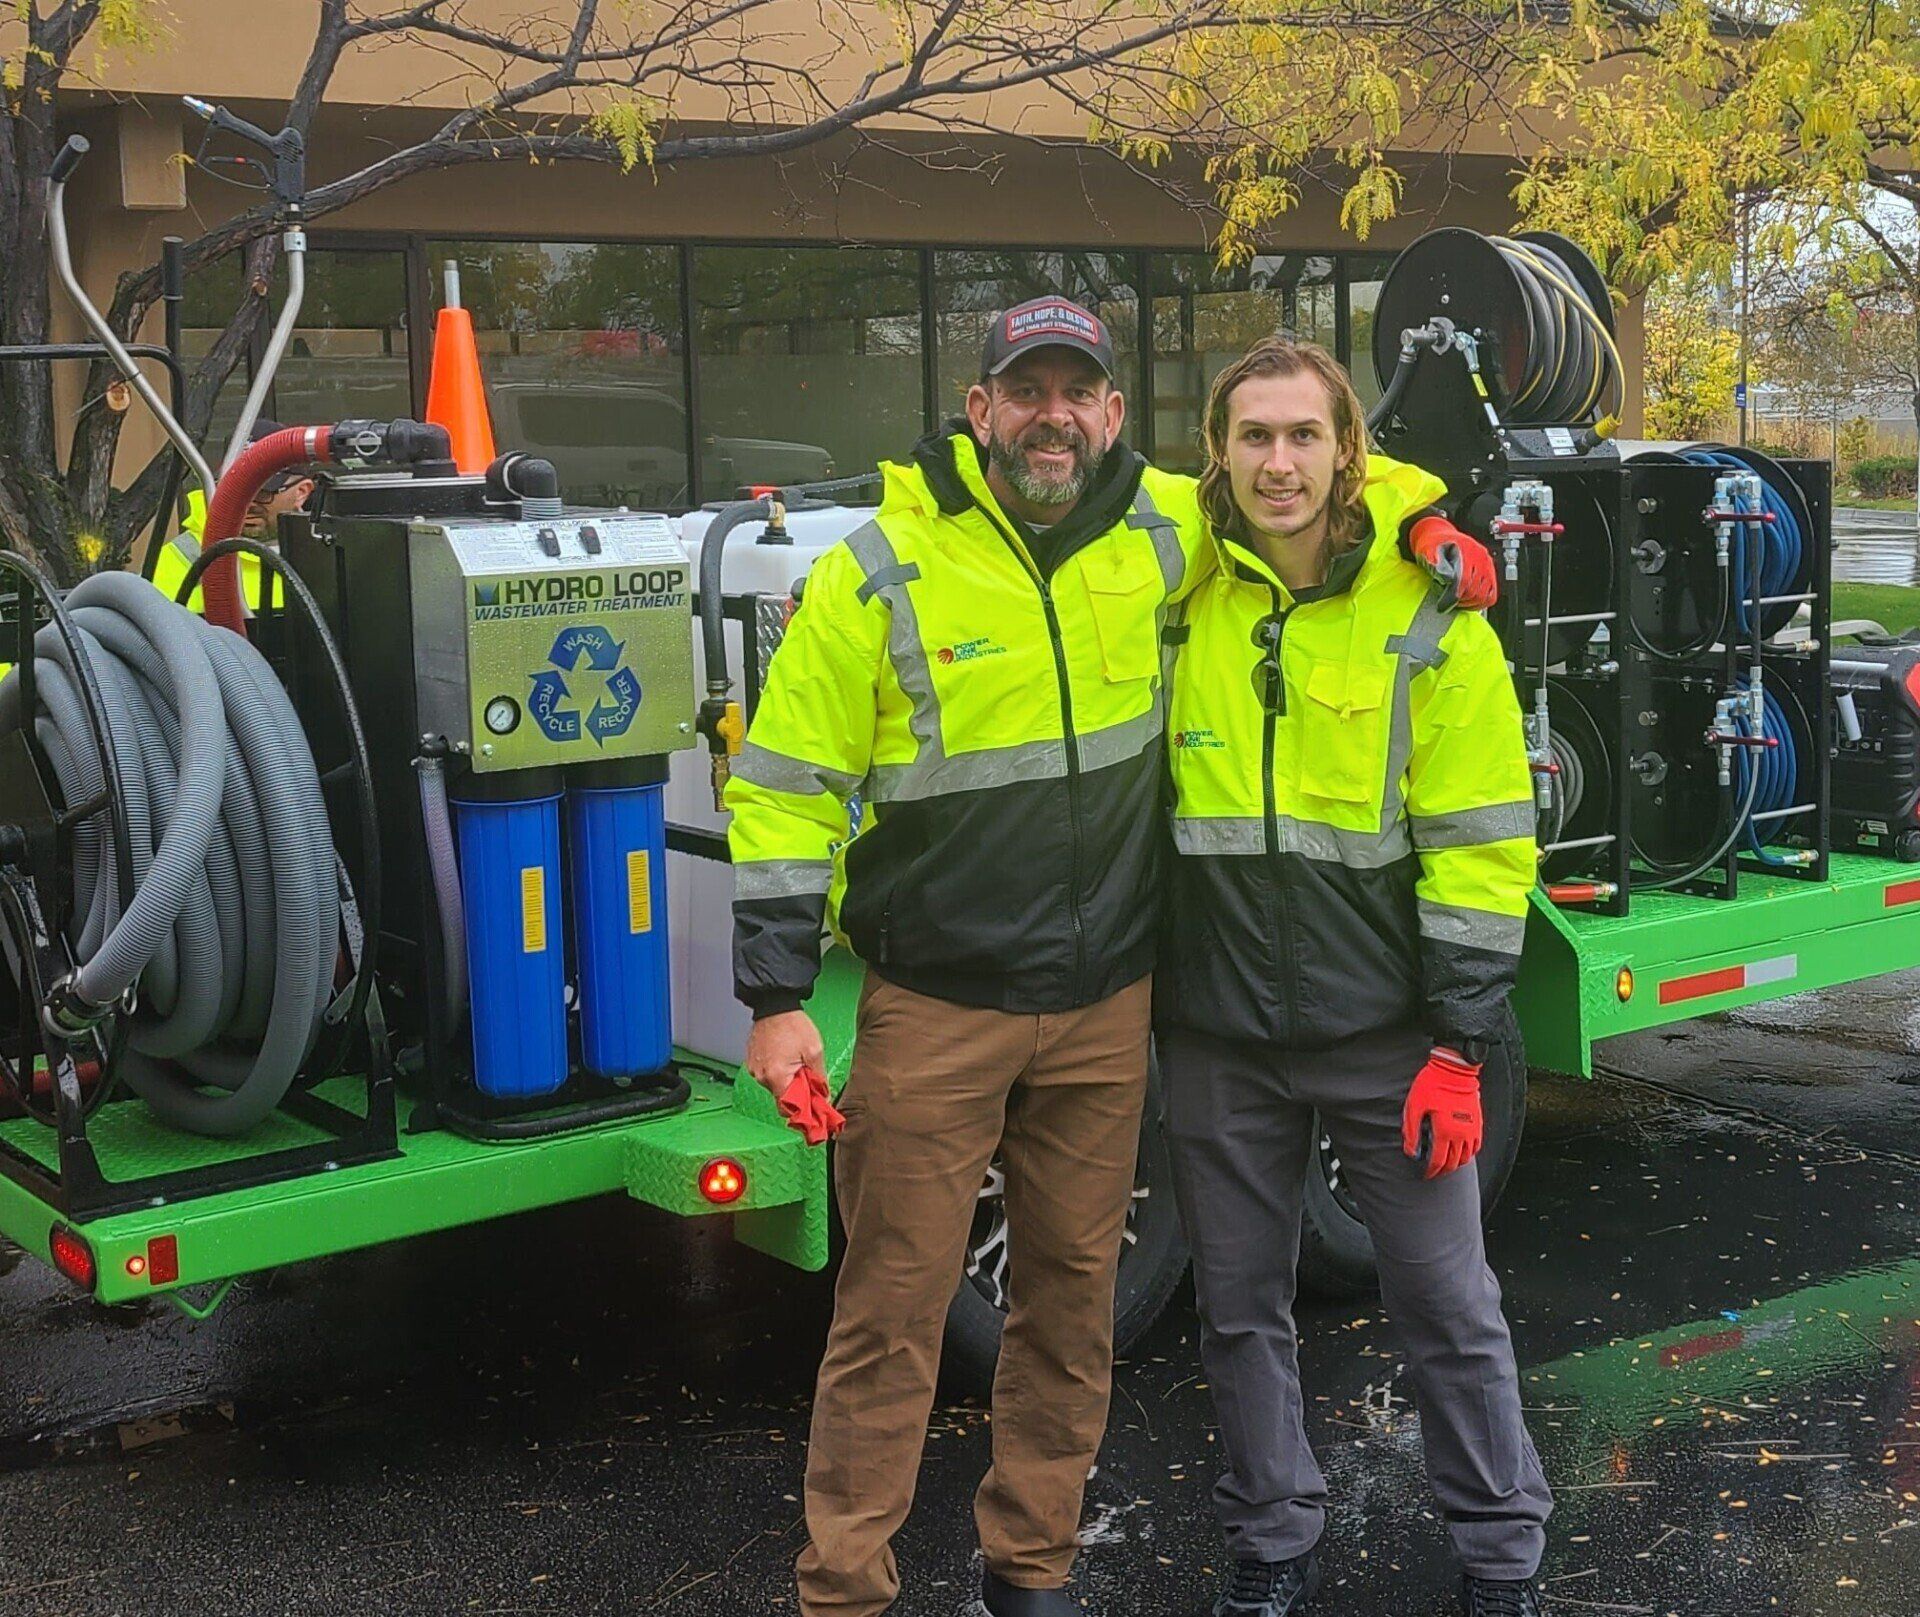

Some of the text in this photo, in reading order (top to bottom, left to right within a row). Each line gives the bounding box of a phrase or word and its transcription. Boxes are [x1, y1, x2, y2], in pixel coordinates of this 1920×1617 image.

[1058, 307, 1065, 319] &
[505, 570, 684, 604] HYDRO LOOP
[474, 600, 588, 621] WASTEWATER
[563, 633, 604, 652] WASH
[954, 637, 989, 650] POWER
[538, 683, 575, 732] RECYCLE
[598, 674, 633, 729] RECOVER
